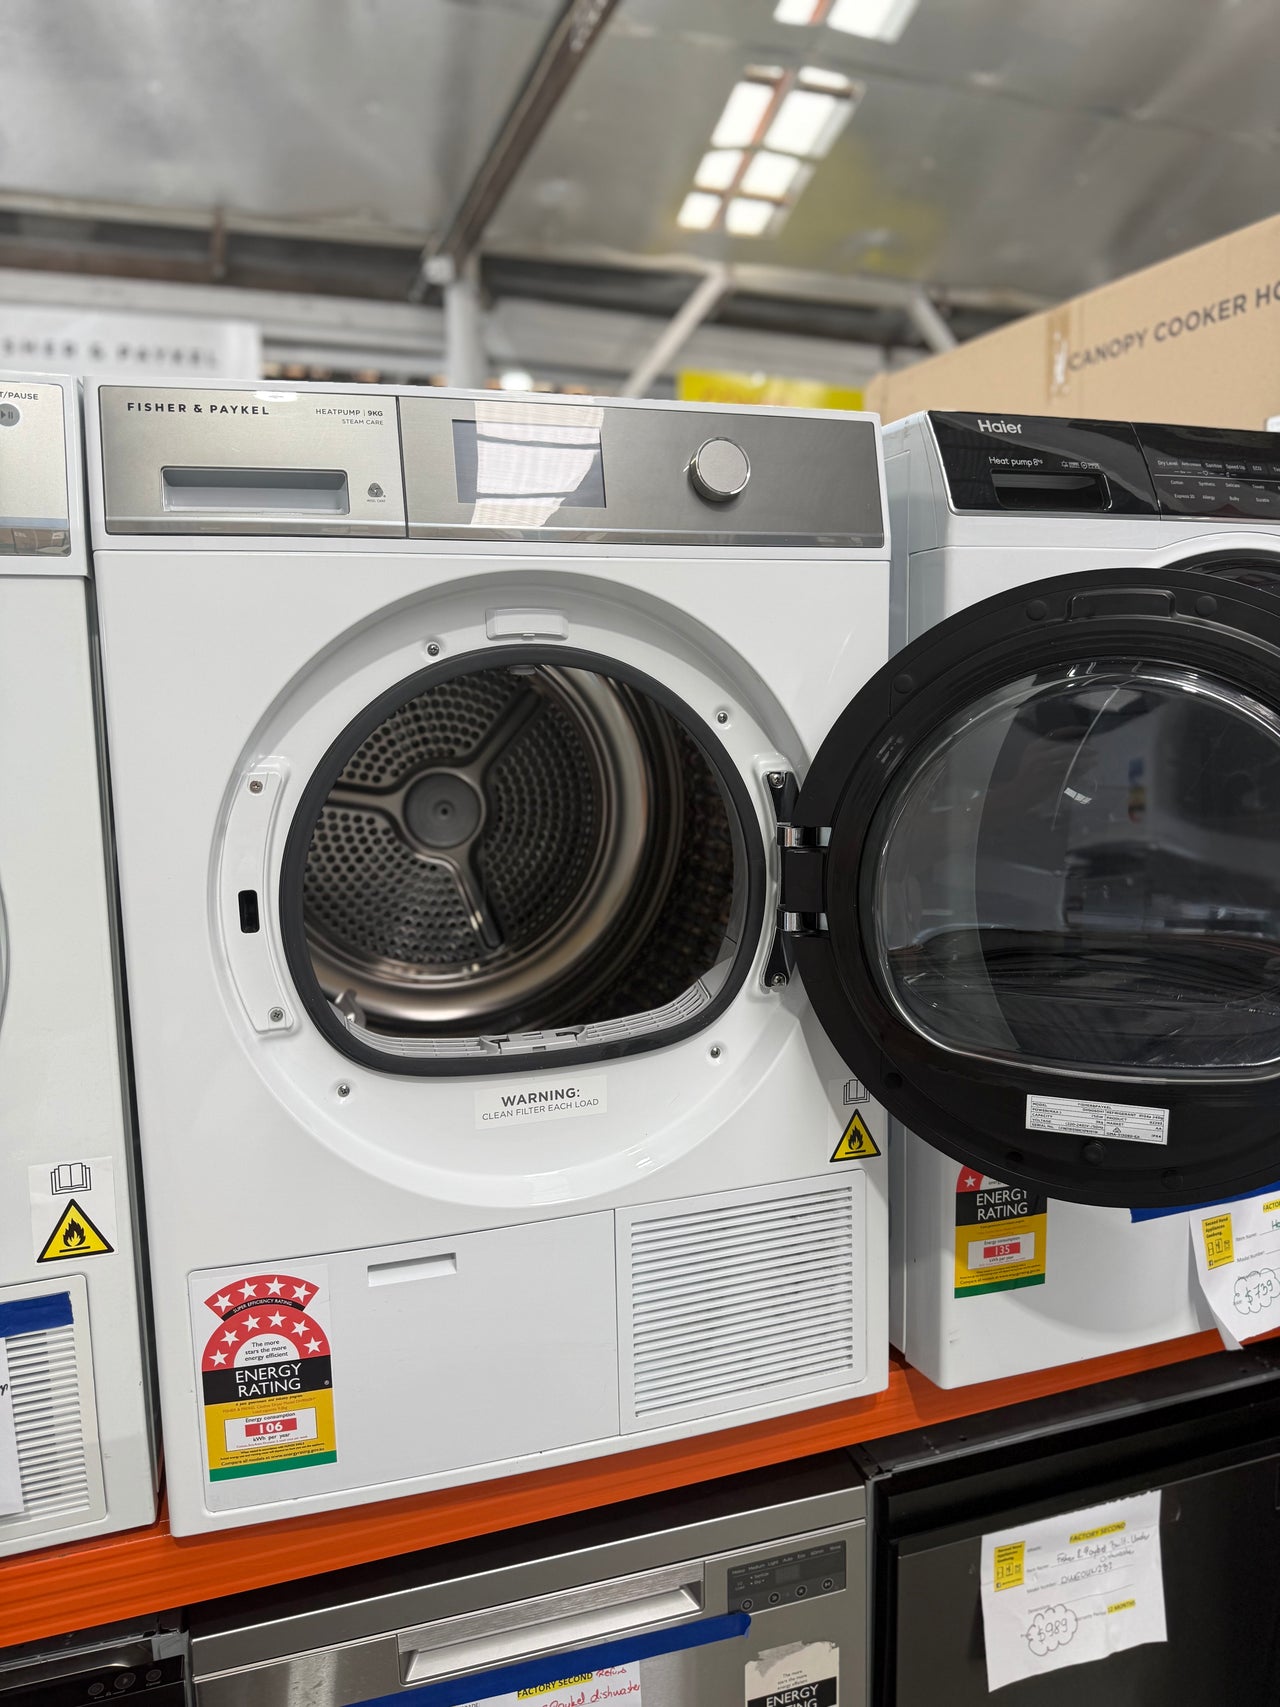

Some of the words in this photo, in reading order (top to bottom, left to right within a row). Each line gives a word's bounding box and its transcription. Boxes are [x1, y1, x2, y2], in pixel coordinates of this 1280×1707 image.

[1067, 328, 1149, 371] CANOPY
[1153, 293, 1248, 343] COOKER
[127, 402, 187, 412] FISHER
[193, 404, 202, 413] &
[210, 405, 269, 415] PAYKEL
[315, 408, 361, 416] HEATPUMP
[977, 419, 1022, 434] Haier
[988, 456, 1010, 465] Heat
[1011, 458, 1033, 468] pump
[501, 1087, 580, 1107] WARNING:
[482, 1110, 513, 1120] CLEAN
[516, 1105, 546, 1116] FILTER
[548, 1102, 573, 1112] EACH
[575, 1098, 599, 1108] LOAD
[977, 1202, 1028, 1221] RATING
[995, 1244, 1010, 1256] 135
[1245, 1280, 1273, 1305] $739
[232, 1304, 247, 1313] SUPER
[247, 1299, 274, 1307] EFFICIENCY
[265, 1351, 288, 1359] efficient
[235, 1362, 302, 1383] ENERGY
[238, 1378, 301, 1398] RATING
[263, 1412, 296, 1421] consumption
[260, 1422, 283, 1434] 106
[1069, 1531, 1099, 1543] FACTORY
[1100, 1521, 1126, 1534] SECOND
[1037, 1618, 1068, 1643] $989
[517, 1682, 556, 1698] FACTORY
[558, 1672, 593, 1687] SECOND
[766, 1684, 819, 1707] ENERGY
